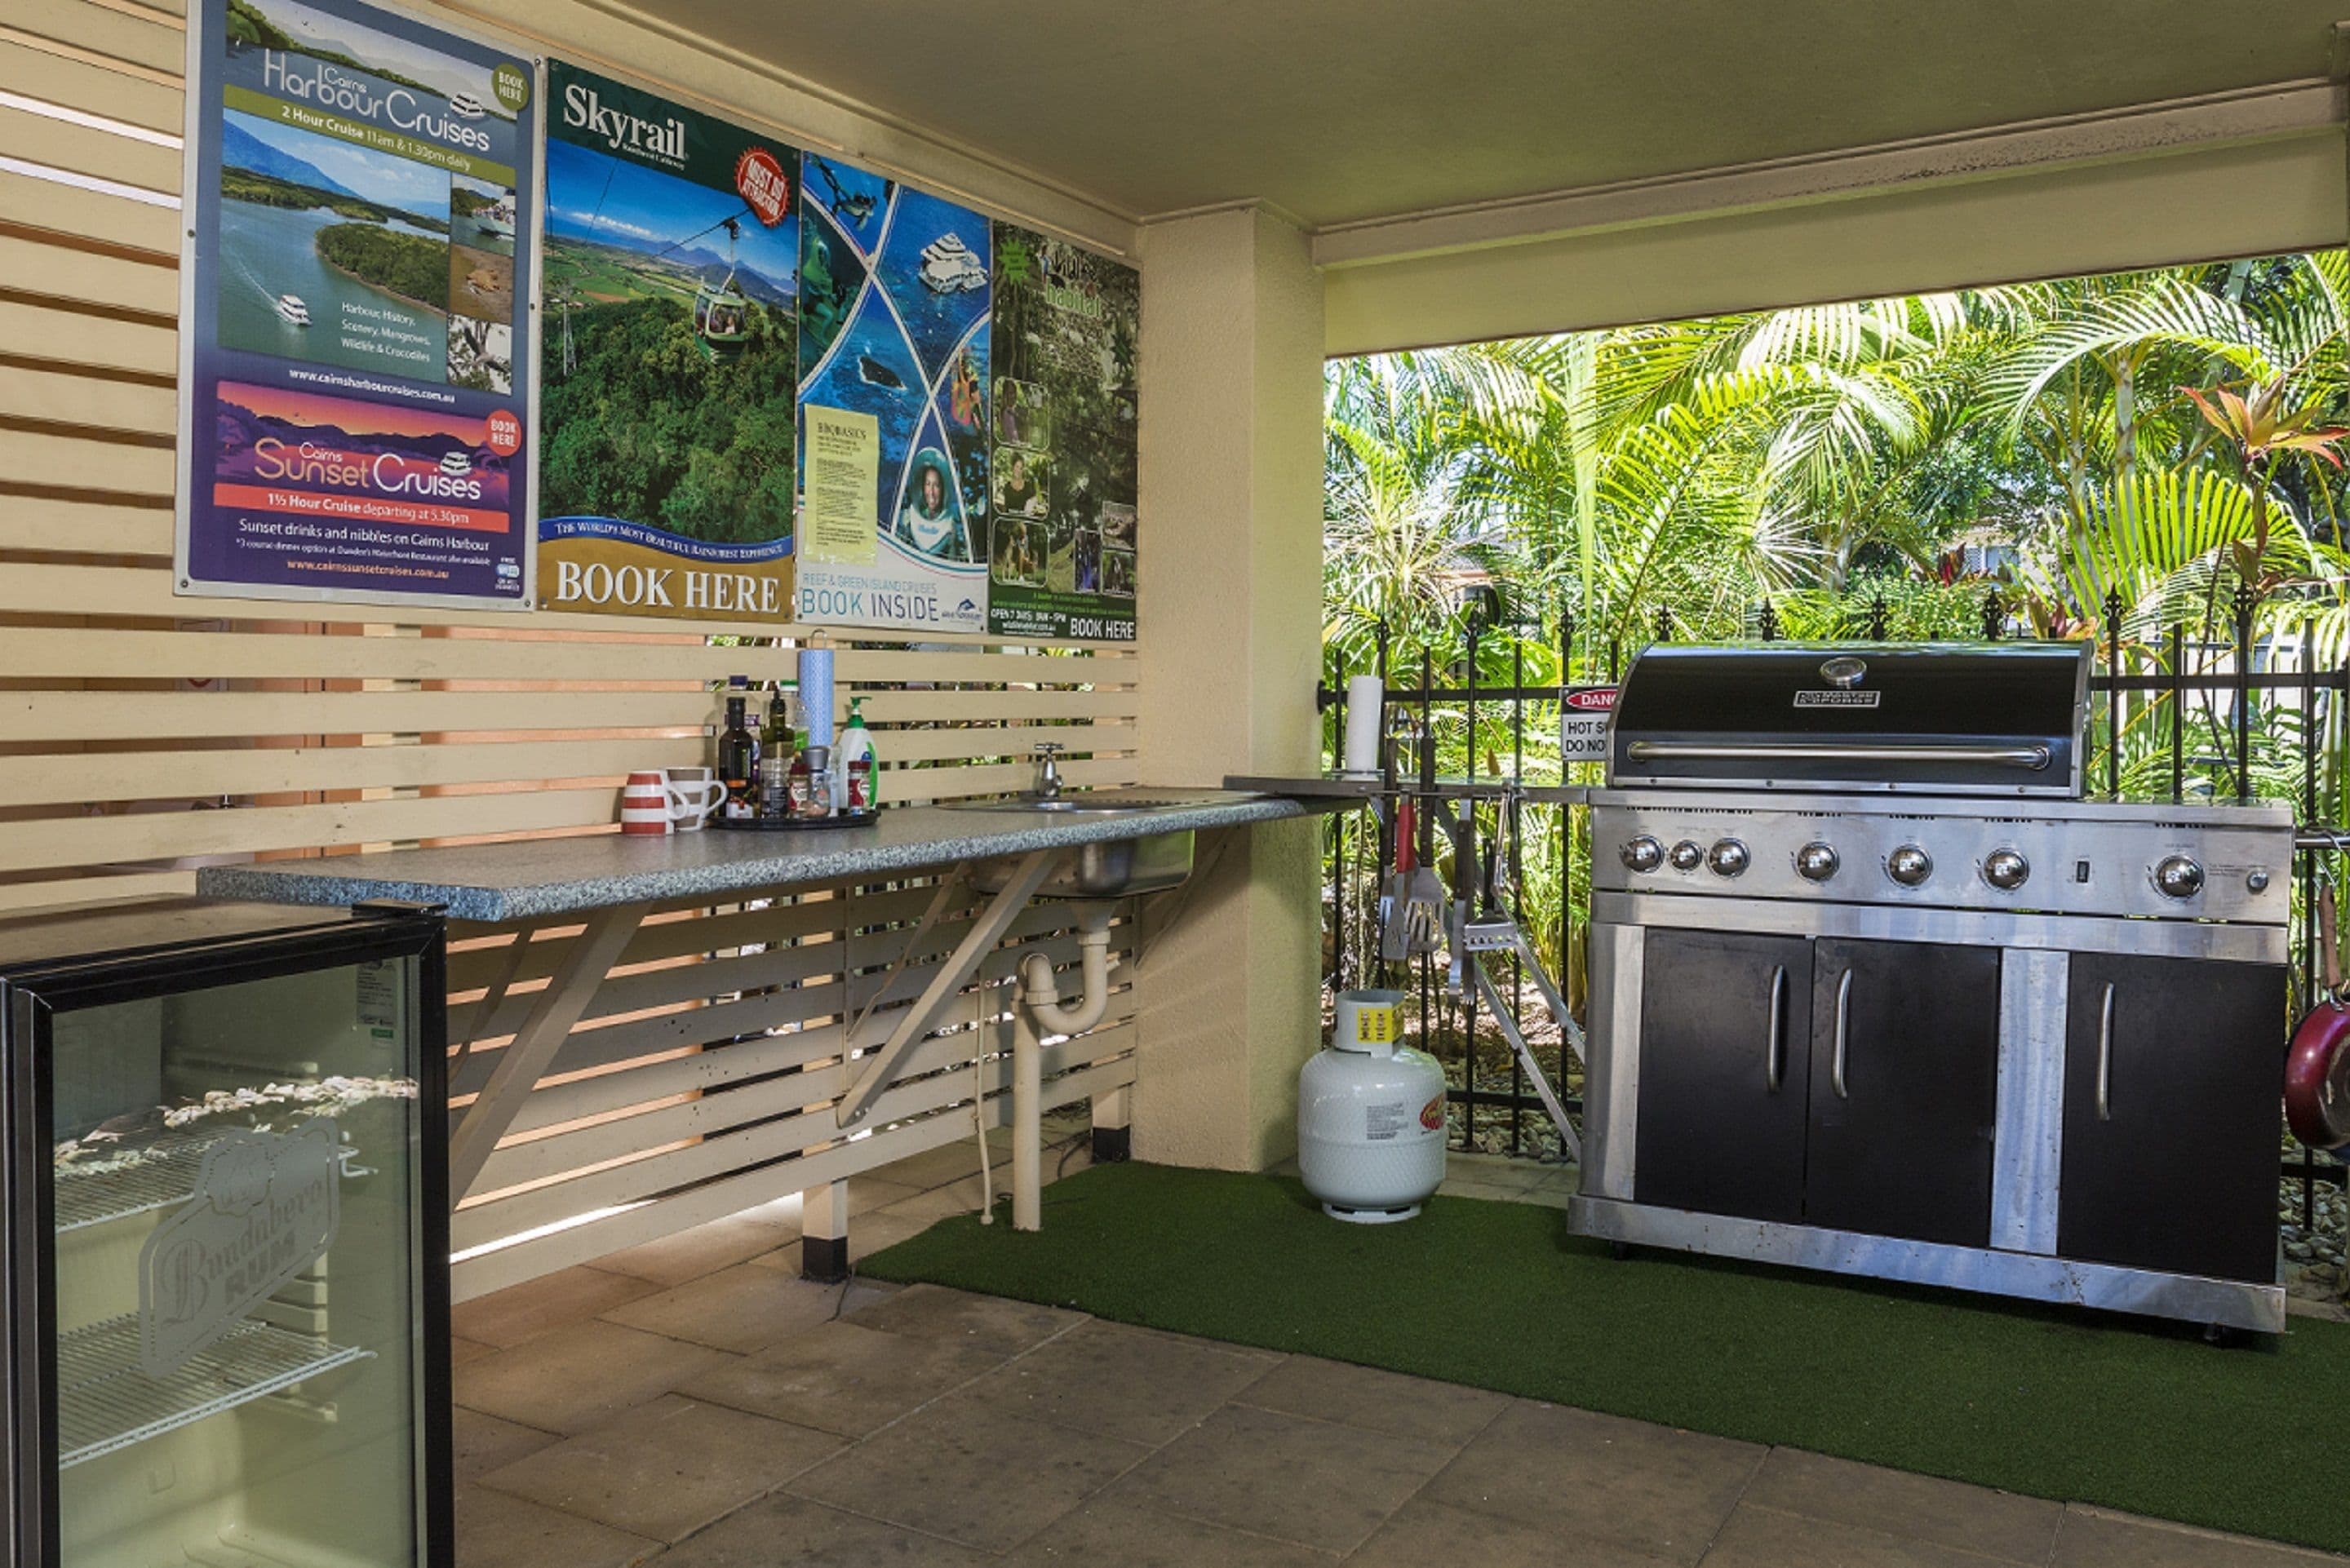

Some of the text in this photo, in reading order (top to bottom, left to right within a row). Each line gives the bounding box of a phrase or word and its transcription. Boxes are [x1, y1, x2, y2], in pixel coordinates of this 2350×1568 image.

[499, 72, 523, 91] BOOK
[264, 48, 490, 152] Harbour Cruises
[499, 83, 521, 103] HERE
[563, 83, 685, 160] Skyrail
[282, 105, 290, 118] 2
[293, 108, 324, 127] Hour
[326, 118, 363, 139] Cruise
[367, 130, 394, 148] 11am
[397, 138, 406, 151] &
[446, 153, 471, 171] daily
[383, 310, 416, 327] History,
[377, 343, 384, 353] &
[385, 344, 431, 363] Crocodiles
[491, 418, 516, 432] BOOK
[491, 432, 516, 447] HERE
[299, 441, 343, 463] Cairns
[254, 437, 481, 500] Sunset Cruises
[289, 494, 321, 508] Hour
[322, 498, 361, 514] Cruise
[363, 503, 416, 521] departing
[419, 510, 428, 520] at
[431, 508, 469, 525] 5.30pm
[238, 518, 490, 551] Sunset drinks and nibbles on Cairns Harbour
[555, 522, 575, 535] THE
[619, 525, 645, 539] MOST
[555, 560, 780, 613] BOOK HERE
[803, 573, 827, 586] REEF
[828, 574, 836, 586] &
[837, 574, 868, 589] GREEN
[868, 578, 901, 592] ISLAND
[802, 588, 939, 622] BOOK INSIDE
[1071, 618, 1102, 637] BOOK
[1105, 620, 1135, 639] HERE
[1567, 721, 1606, 734] HOT S
[1566, 739, 1585, 752] DO
[162, 1180, 323, 1324] Bundaberg
[224, 1229, 298, 1305] RUM
